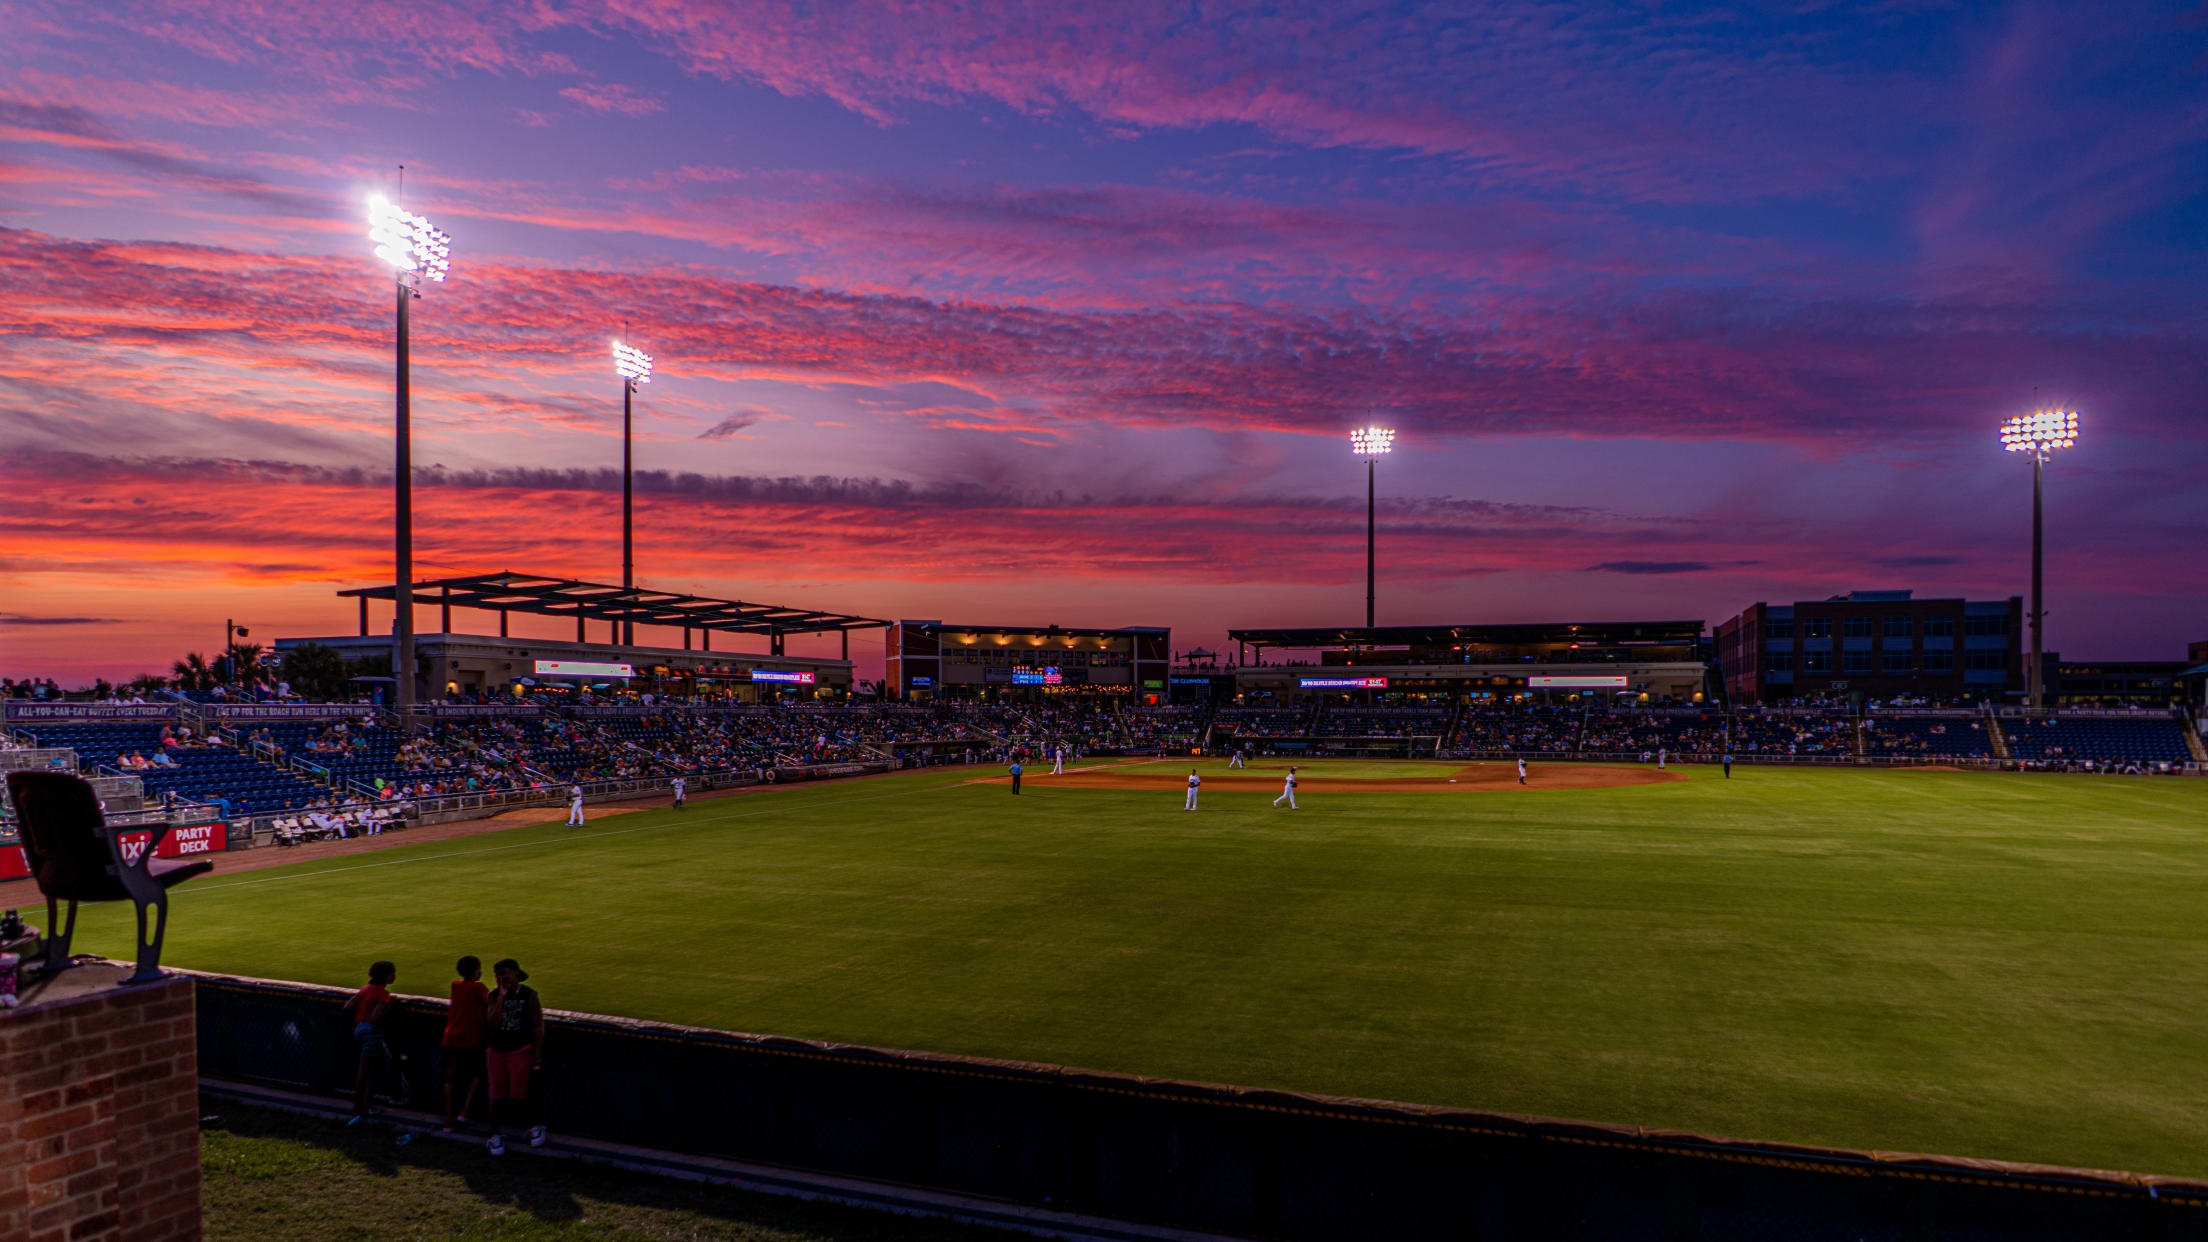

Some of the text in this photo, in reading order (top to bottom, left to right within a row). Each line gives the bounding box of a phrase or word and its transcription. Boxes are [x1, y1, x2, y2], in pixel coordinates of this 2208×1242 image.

[17, 706, 87, 717] ALL-YOU-CAN-EAT
[176, 826, 212, 841] PARTY
[180, 840, 209, 854] DECK
